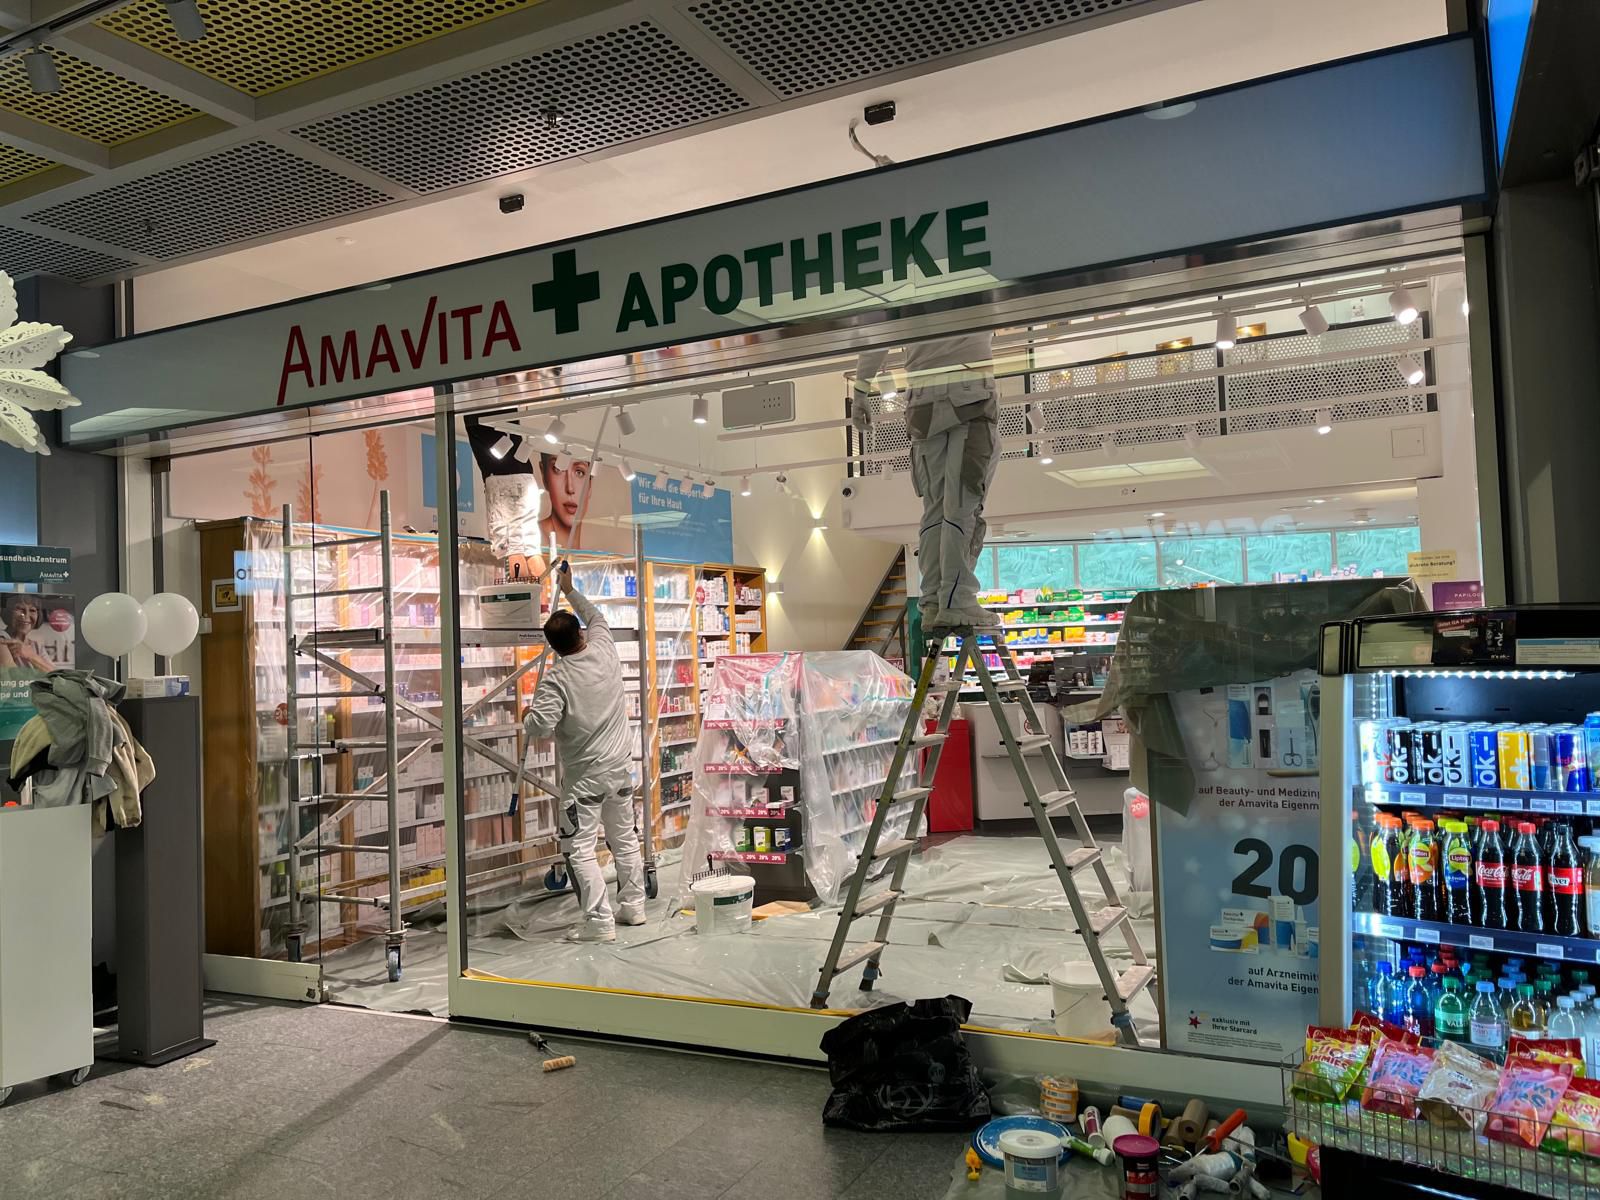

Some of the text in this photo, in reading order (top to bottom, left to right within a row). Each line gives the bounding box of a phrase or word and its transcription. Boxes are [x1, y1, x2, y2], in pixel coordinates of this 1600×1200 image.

[278, 201, 992, 406] AMAVITA APOTHEKE
[638, 477, 651, 489] Wir
[638, 492, 682, 511] für Ihre Haut
[13, 690, 28, 698] und
[1198, 786, 1213, 794] auf
[1216, 786, 1254, 797] Beauty-
[1219, 799, 1235, 807] der
[1238, 800, 1278, 808] Amavita
[1248, 967, 1264, 976] auf
[1228, 976, 1244, 985] der
[1247, 978, 1288, 990] Amavita
[1230, 1025, 1257, 1035] Starcard
